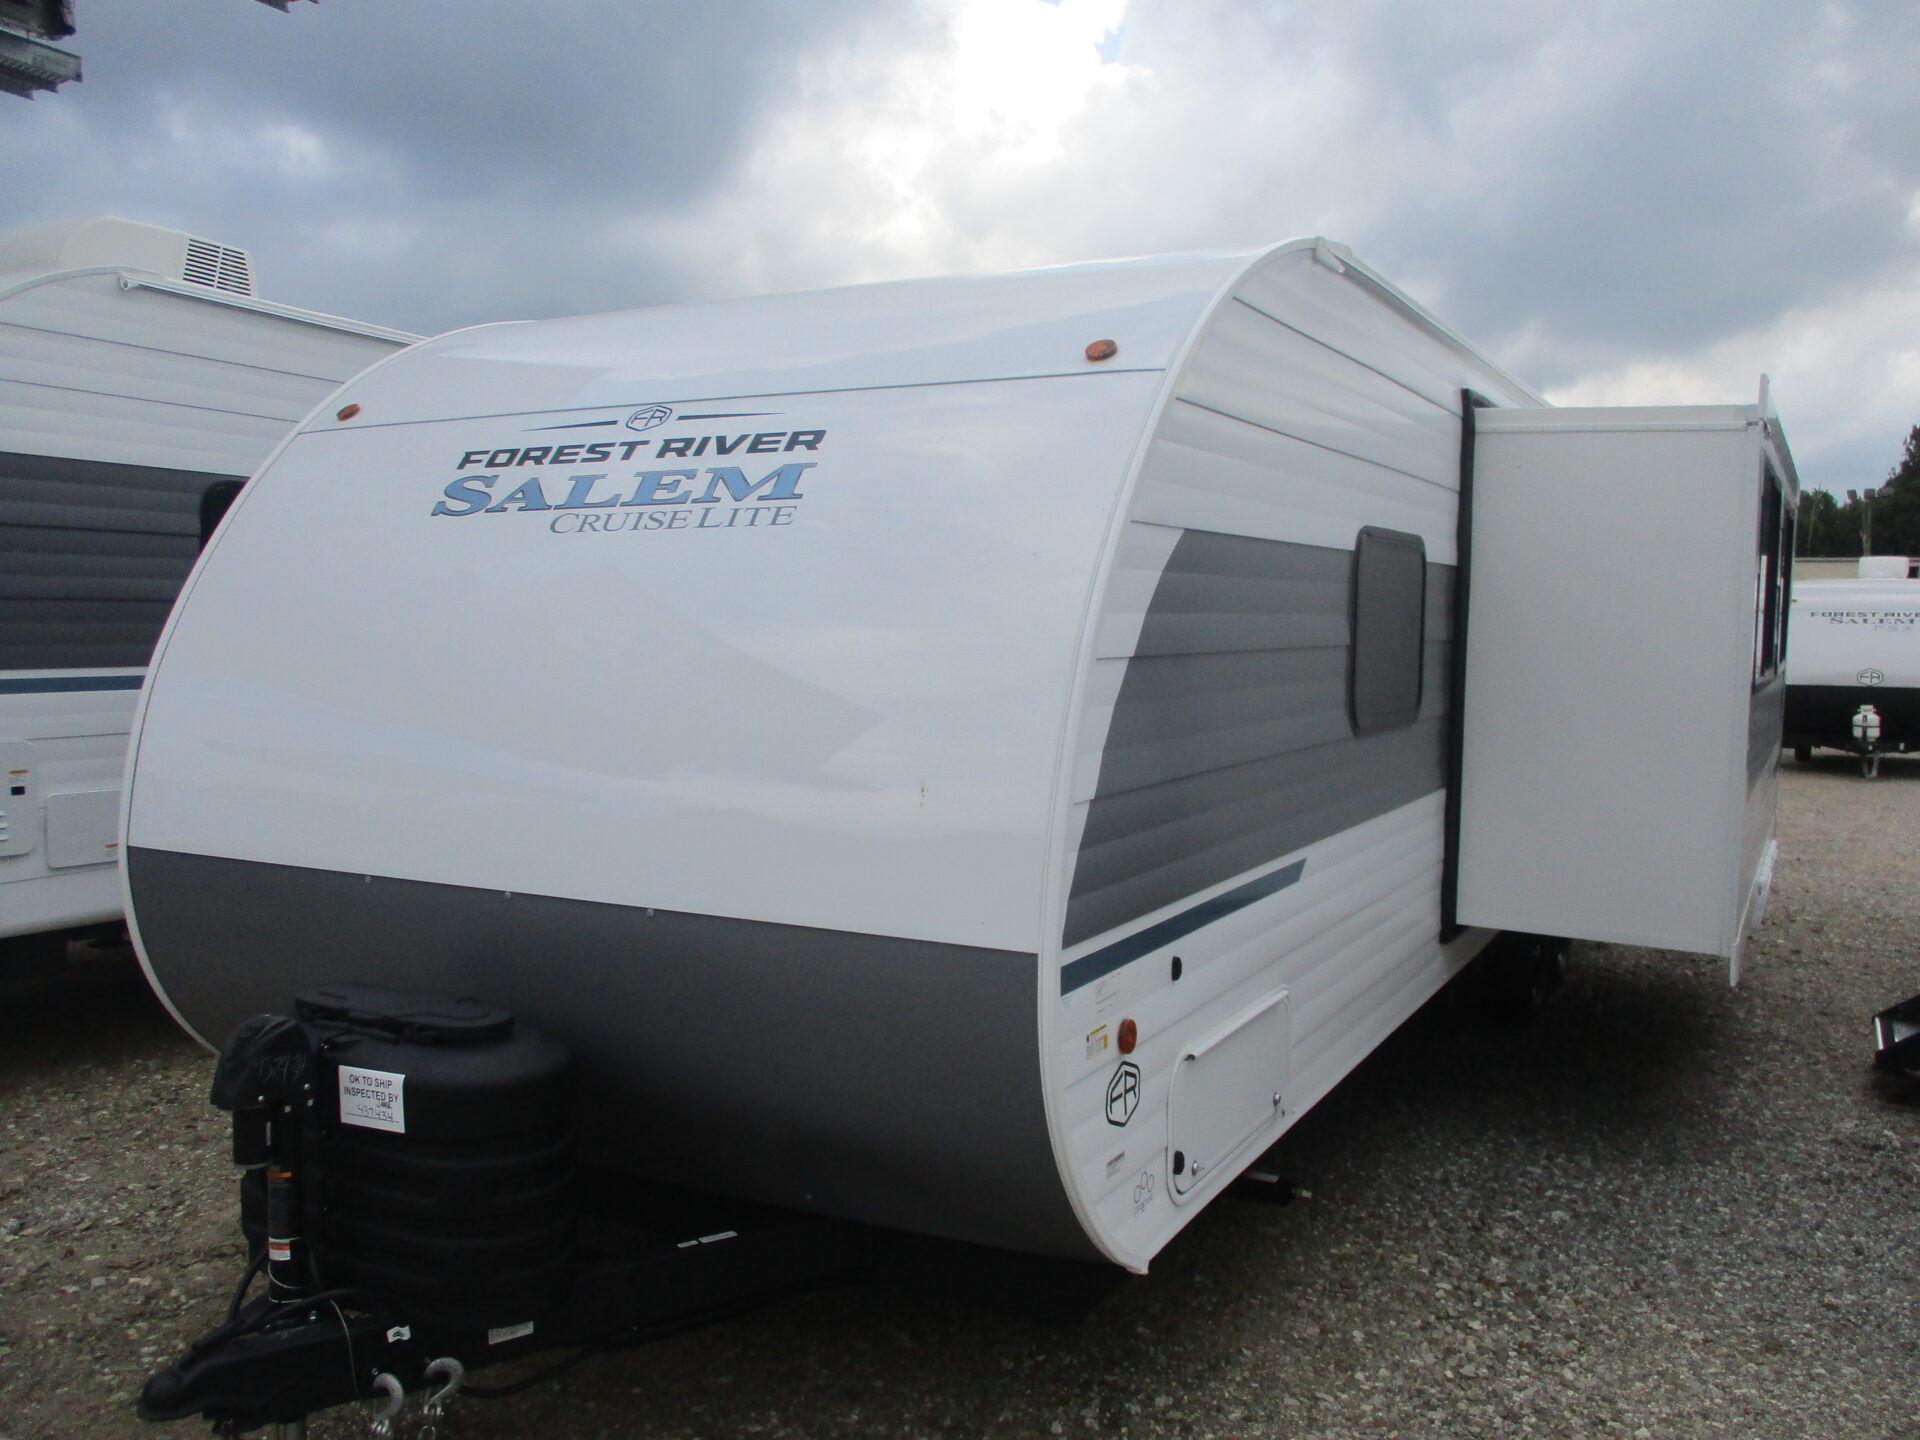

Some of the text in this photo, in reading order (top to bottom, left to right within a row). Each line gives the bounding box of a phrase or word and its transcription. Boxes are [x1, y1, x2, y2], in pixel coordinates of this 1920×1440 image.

[456, 429, 828, 470] FOREST RIVER
[431, 462, 819, 517] SALEM
[1830, 617, 1916, 625] SALEM
[349, 1074, 393, 1089] OK TO SHIP
[343, 1086, 399, 1103] INSPECTED BY
